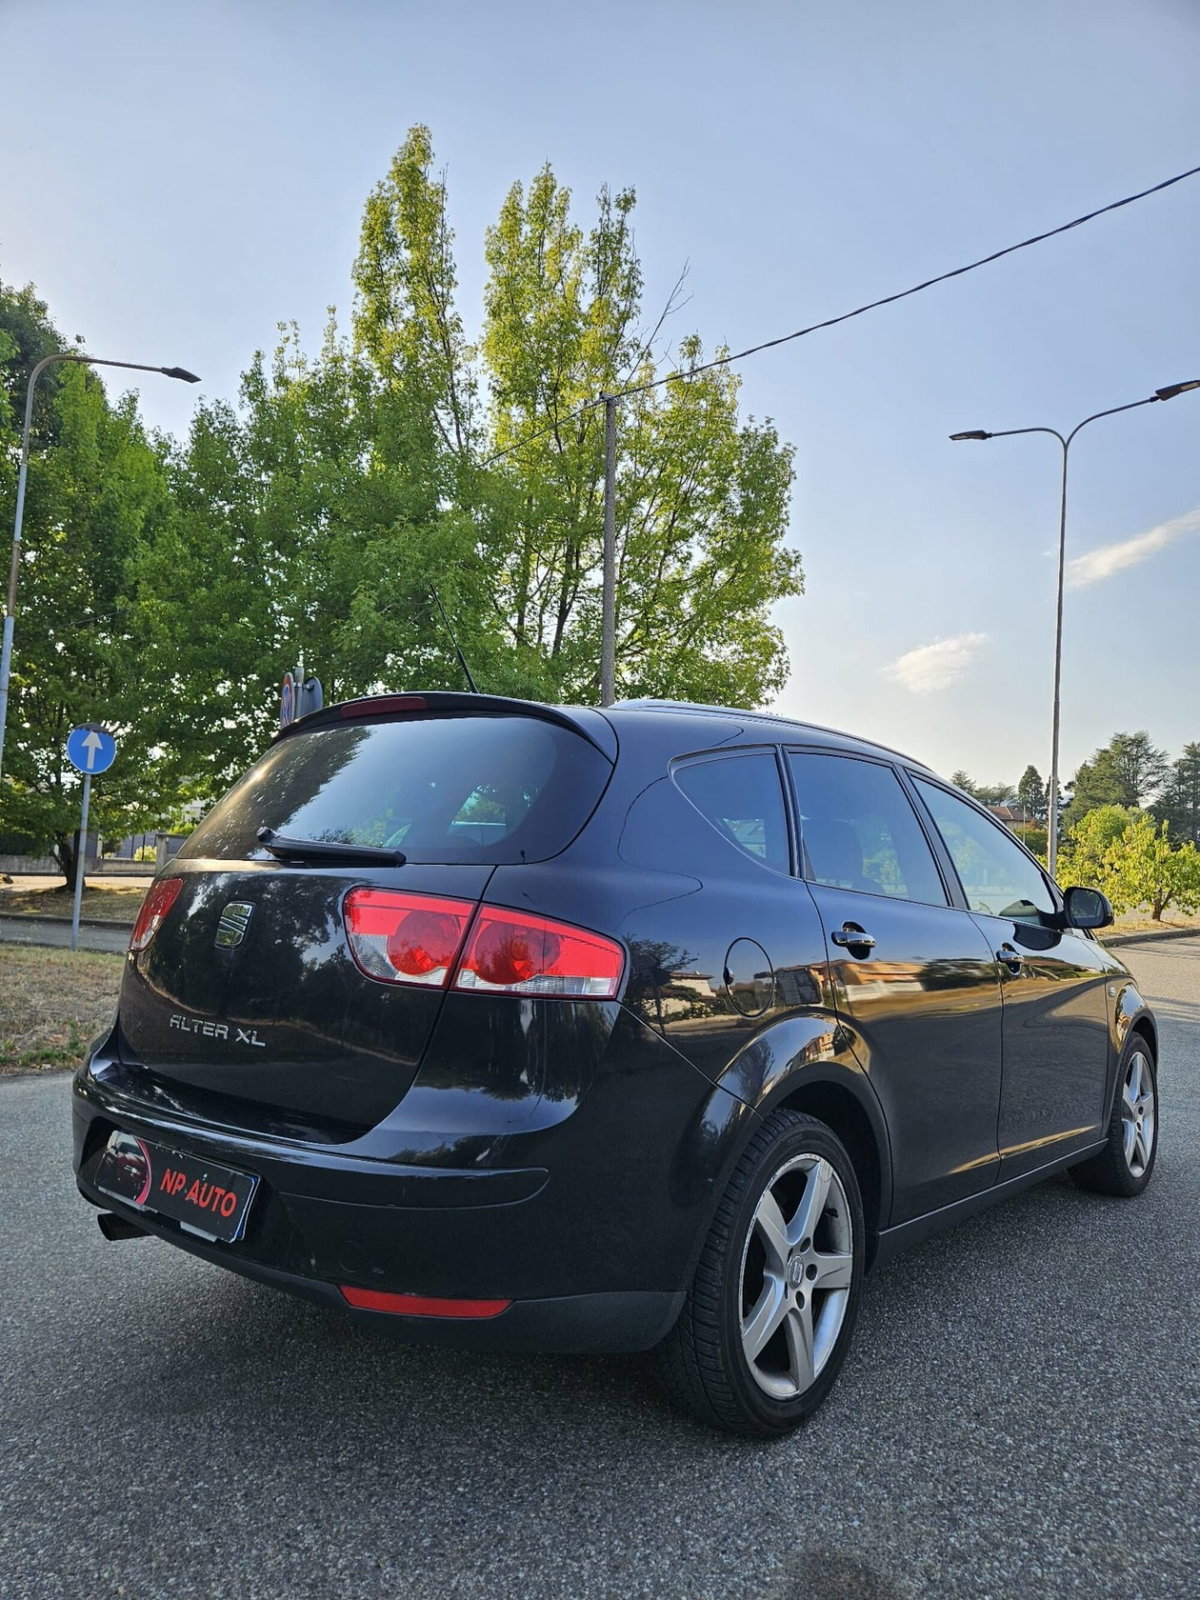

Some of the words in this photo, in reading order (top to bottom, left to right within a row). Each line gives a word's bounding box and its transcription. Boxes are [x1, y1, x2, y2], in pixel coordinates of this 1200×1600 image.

[235, 1028, 266, 1047] XL
[159, 1168, 186, 1196] NP
[185, 1179, 238, 1217] AUTO
